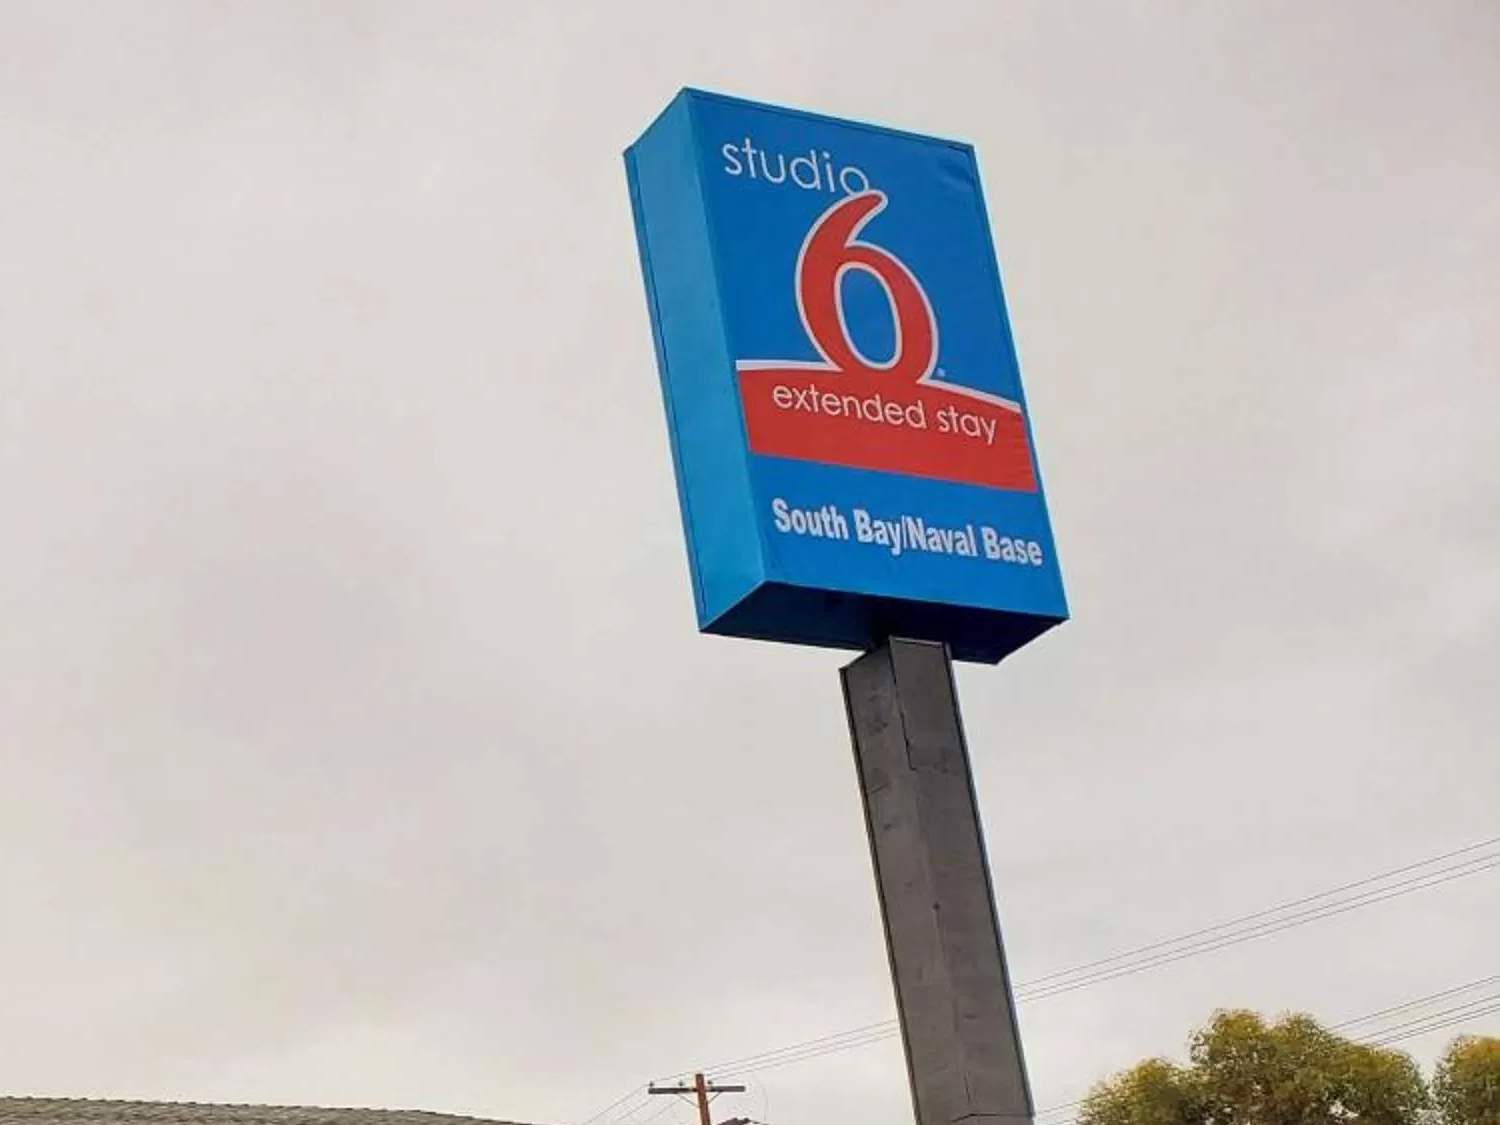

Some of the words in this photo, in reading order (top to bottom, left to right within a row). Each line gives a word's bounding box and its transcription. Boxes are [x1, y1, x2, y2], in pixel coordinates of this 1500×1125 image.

[722, 137, 869, 196] studio
[796, 189, 938, 378] 6
[772, 384, 927, 428] extended
[936, 404, 997, 445] stay
[772, 498, 849, 540] South
[853, 509, 978, 557] Bay/Naval
[980, 526, 1043, 567] Base
